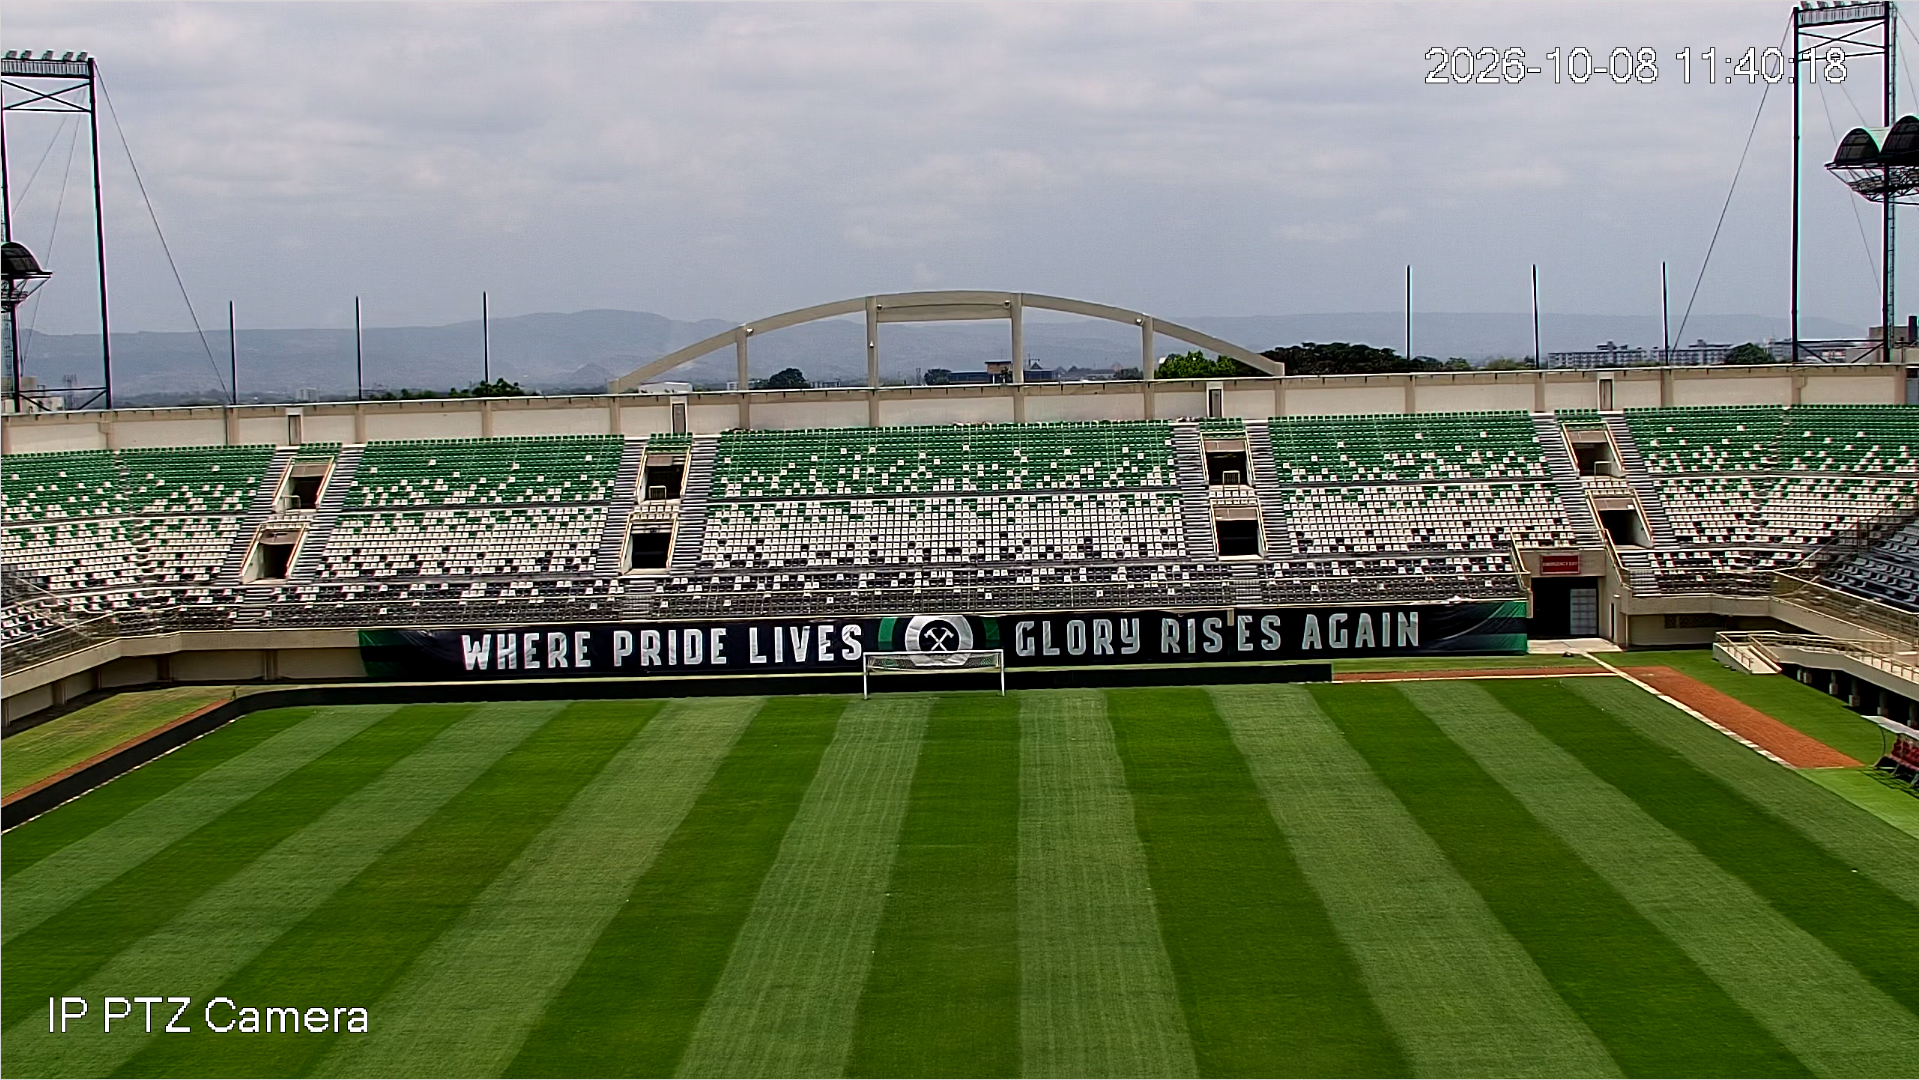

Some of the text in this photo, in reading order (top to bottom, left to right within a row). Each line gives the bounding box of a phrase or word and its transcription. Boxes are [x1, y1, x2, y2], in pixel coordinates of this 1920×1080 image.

[461, 612, 1419, 671] WHERE PRIDE LIVES GLORY RISES AGAIN
